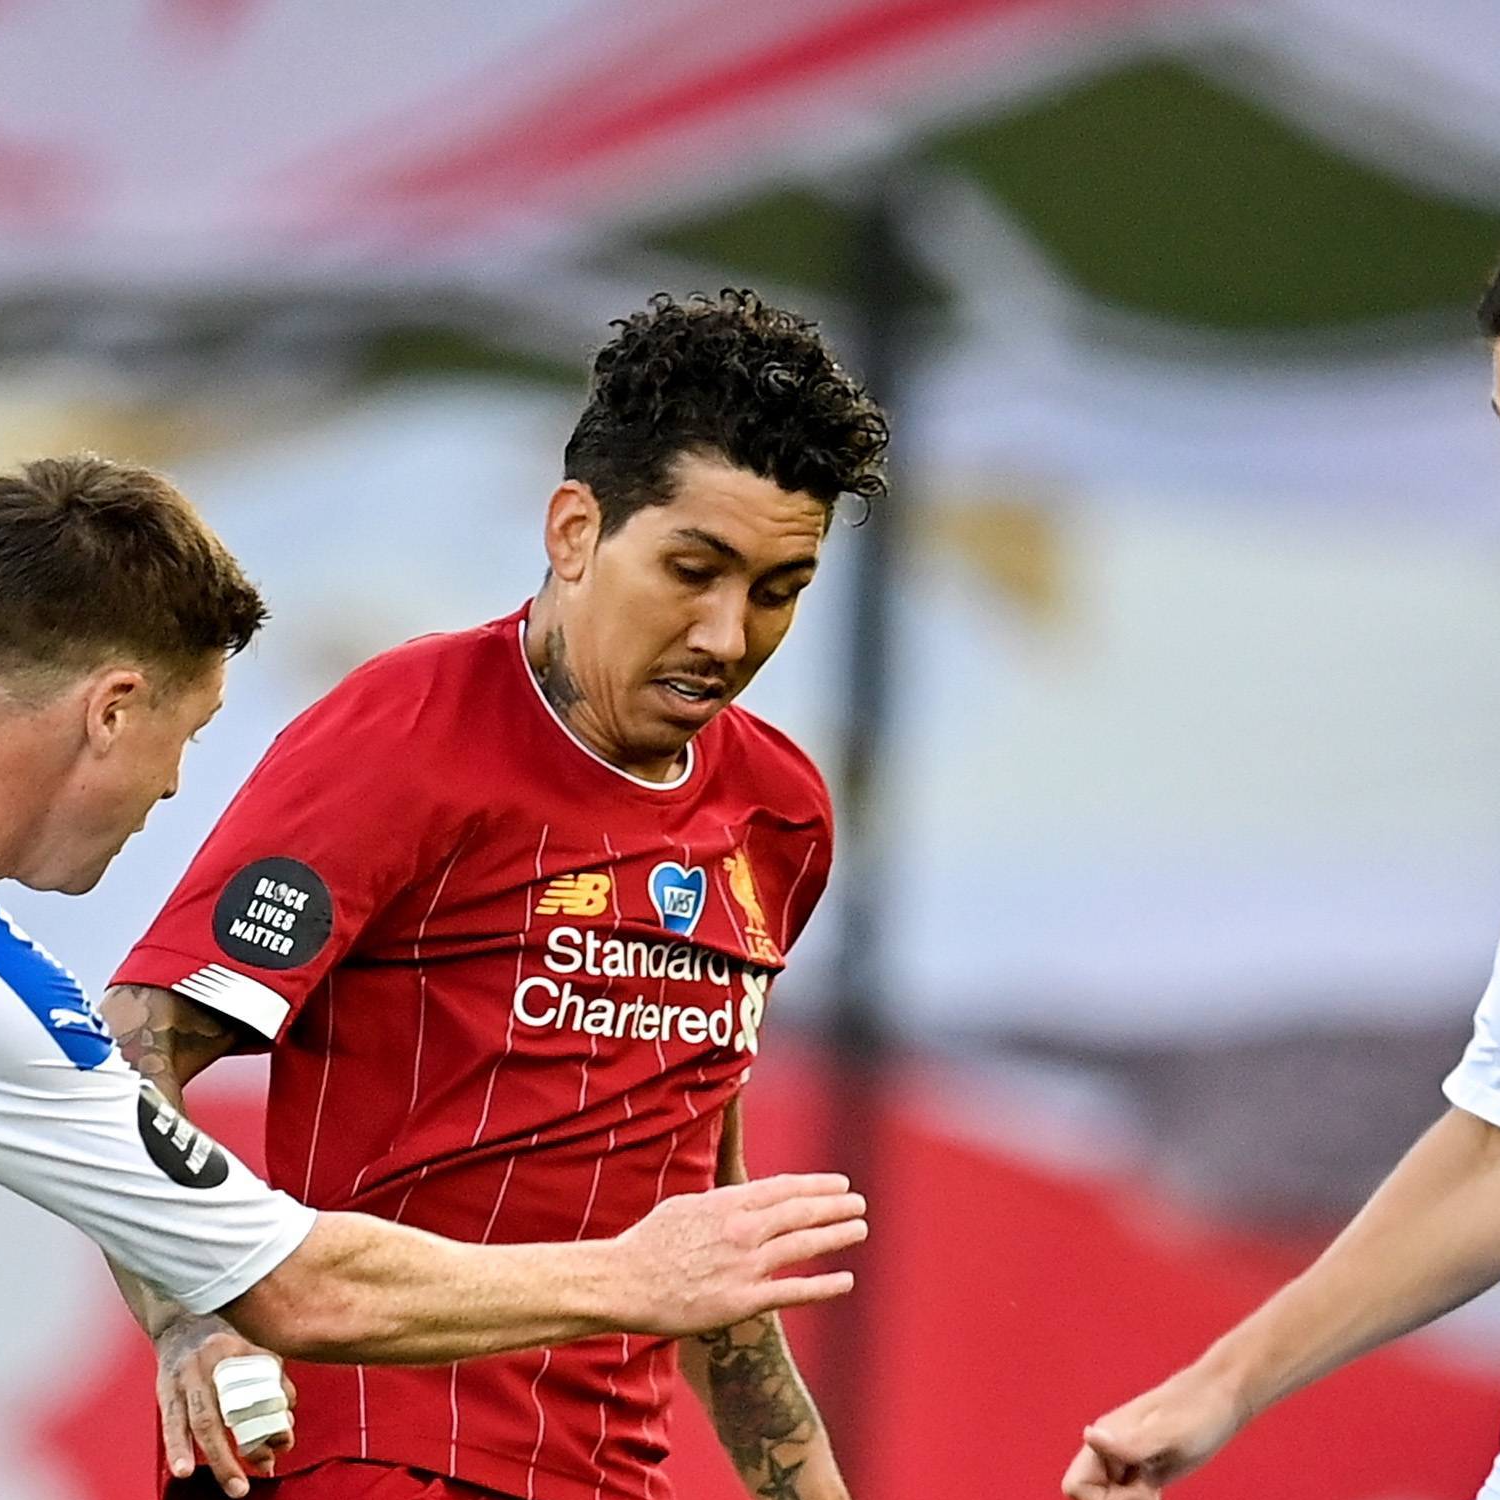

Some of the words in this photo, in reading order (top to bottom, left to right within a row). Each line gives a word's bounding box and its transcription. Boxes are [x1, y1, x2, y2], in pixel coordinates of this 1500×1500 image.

[246, 899, 296, 931] LIVES
[665, 888, 696, 917] NHS
[228, 918, 295, 956] MATTER
[543, 926, 731, 987] Standard
[512, 976, 733, 1047] Chartered
